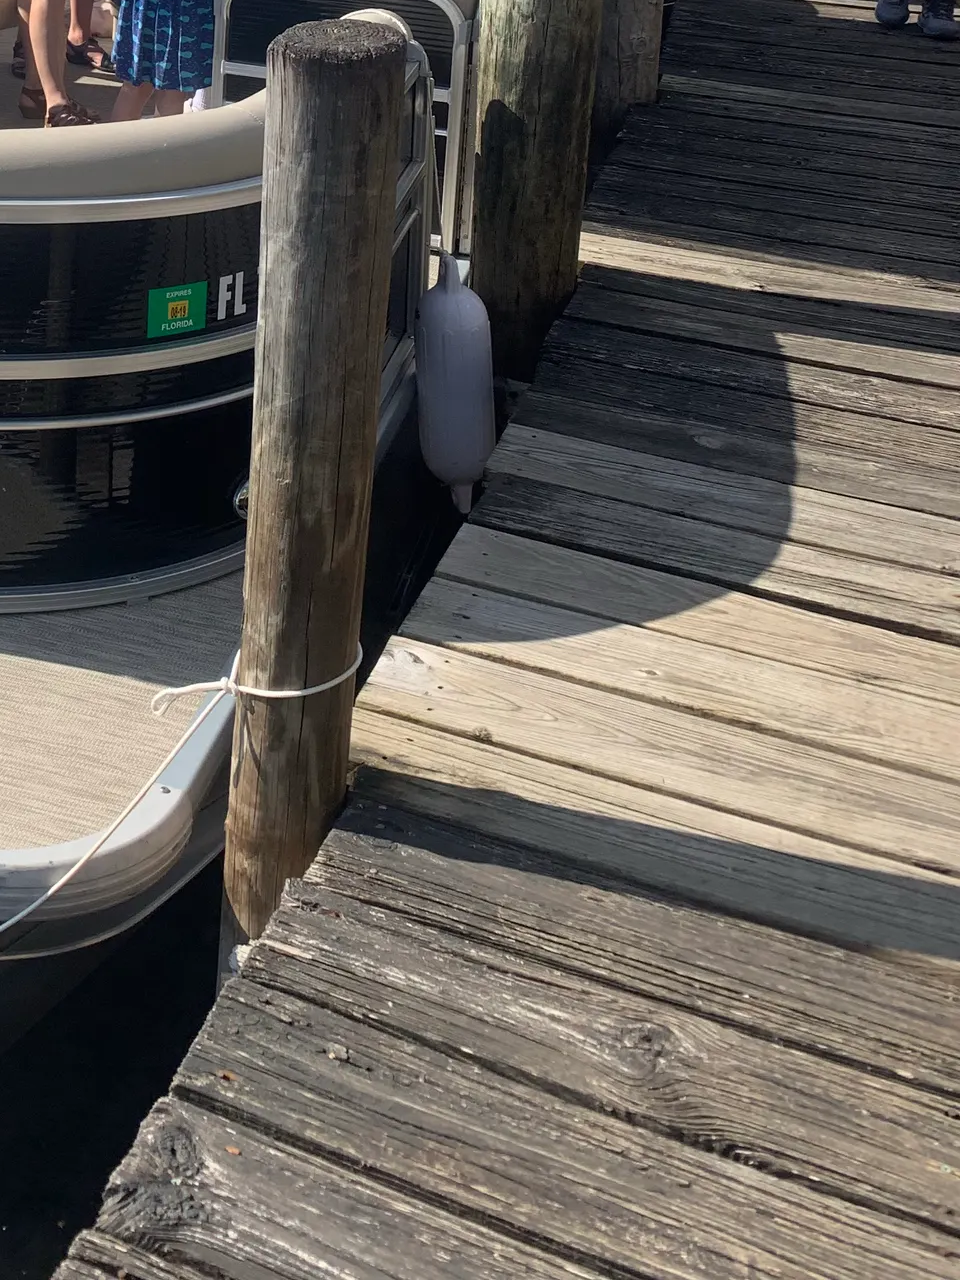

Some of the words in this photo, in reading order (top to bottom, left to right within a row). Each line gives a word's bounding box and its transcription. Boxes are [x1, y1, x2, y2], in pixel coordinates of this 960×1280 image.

[166, 289, 192, 299] EXPIRES
[217, 271, 246, 320] FL
[161, 319, 193, 331] FLORIDA
